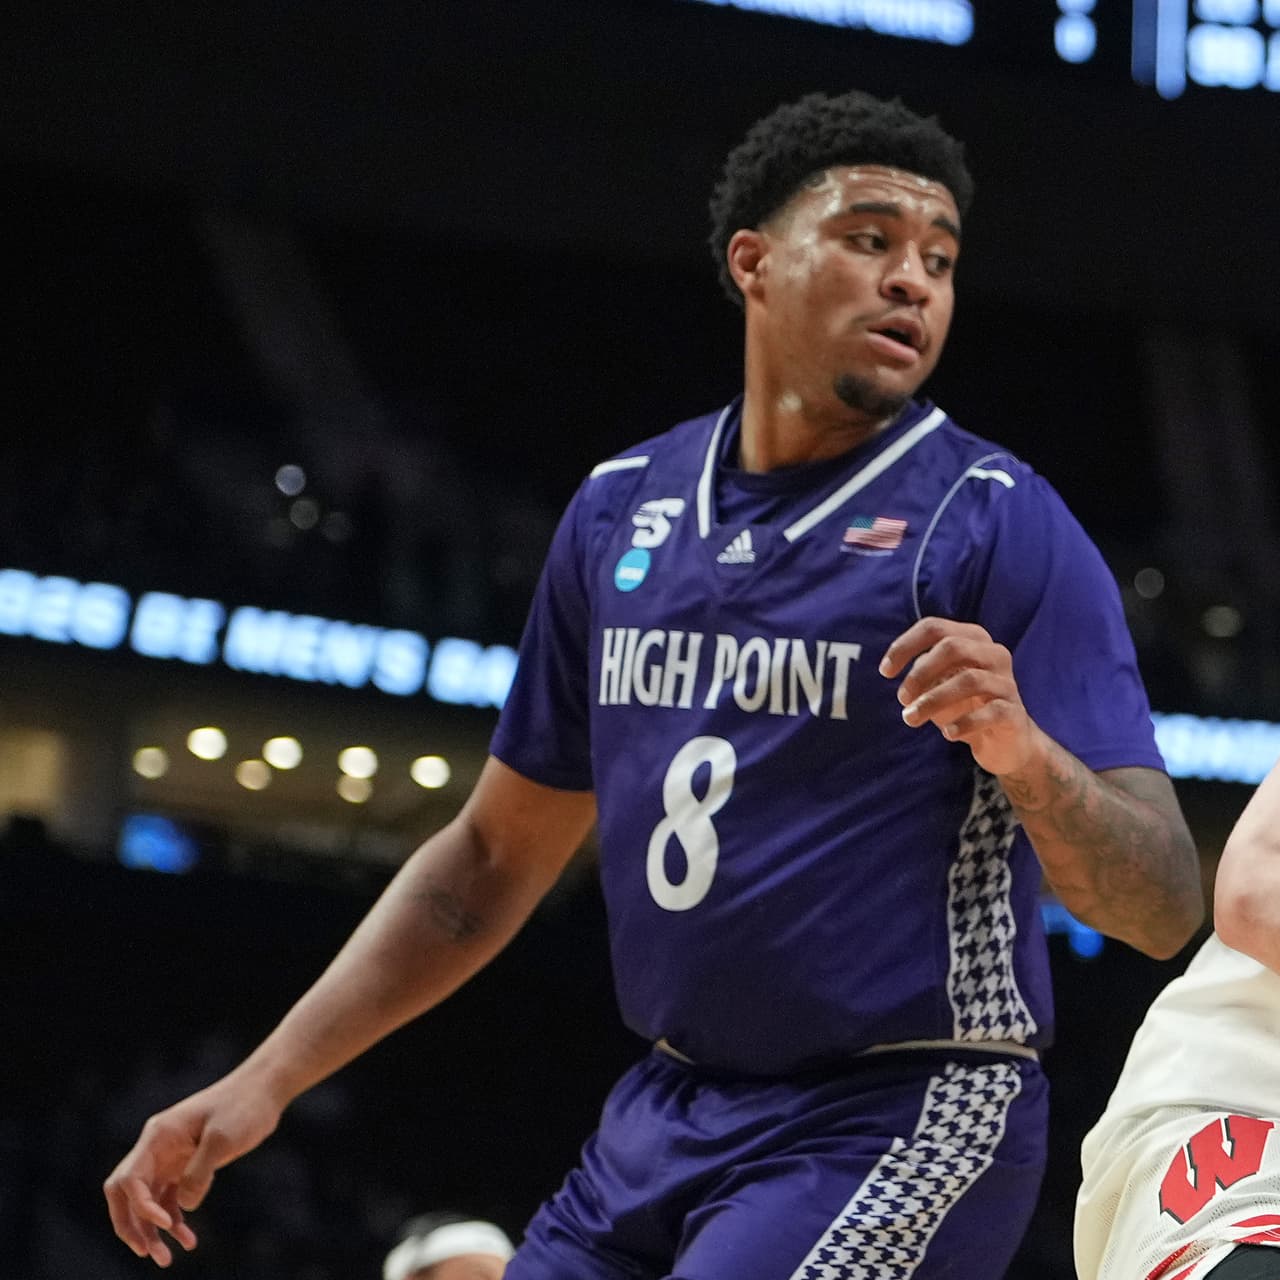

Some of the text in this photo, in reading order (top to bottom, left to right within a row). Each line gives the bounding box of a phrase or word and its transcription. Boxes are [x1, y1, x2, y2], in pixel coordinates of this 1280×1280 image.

[600, 627, 702, 709] HIGH
[703, 633, 861, 720] POINT
[646, 735, 737, 912] 8
[1159, 1114, 1275, 1225] W
